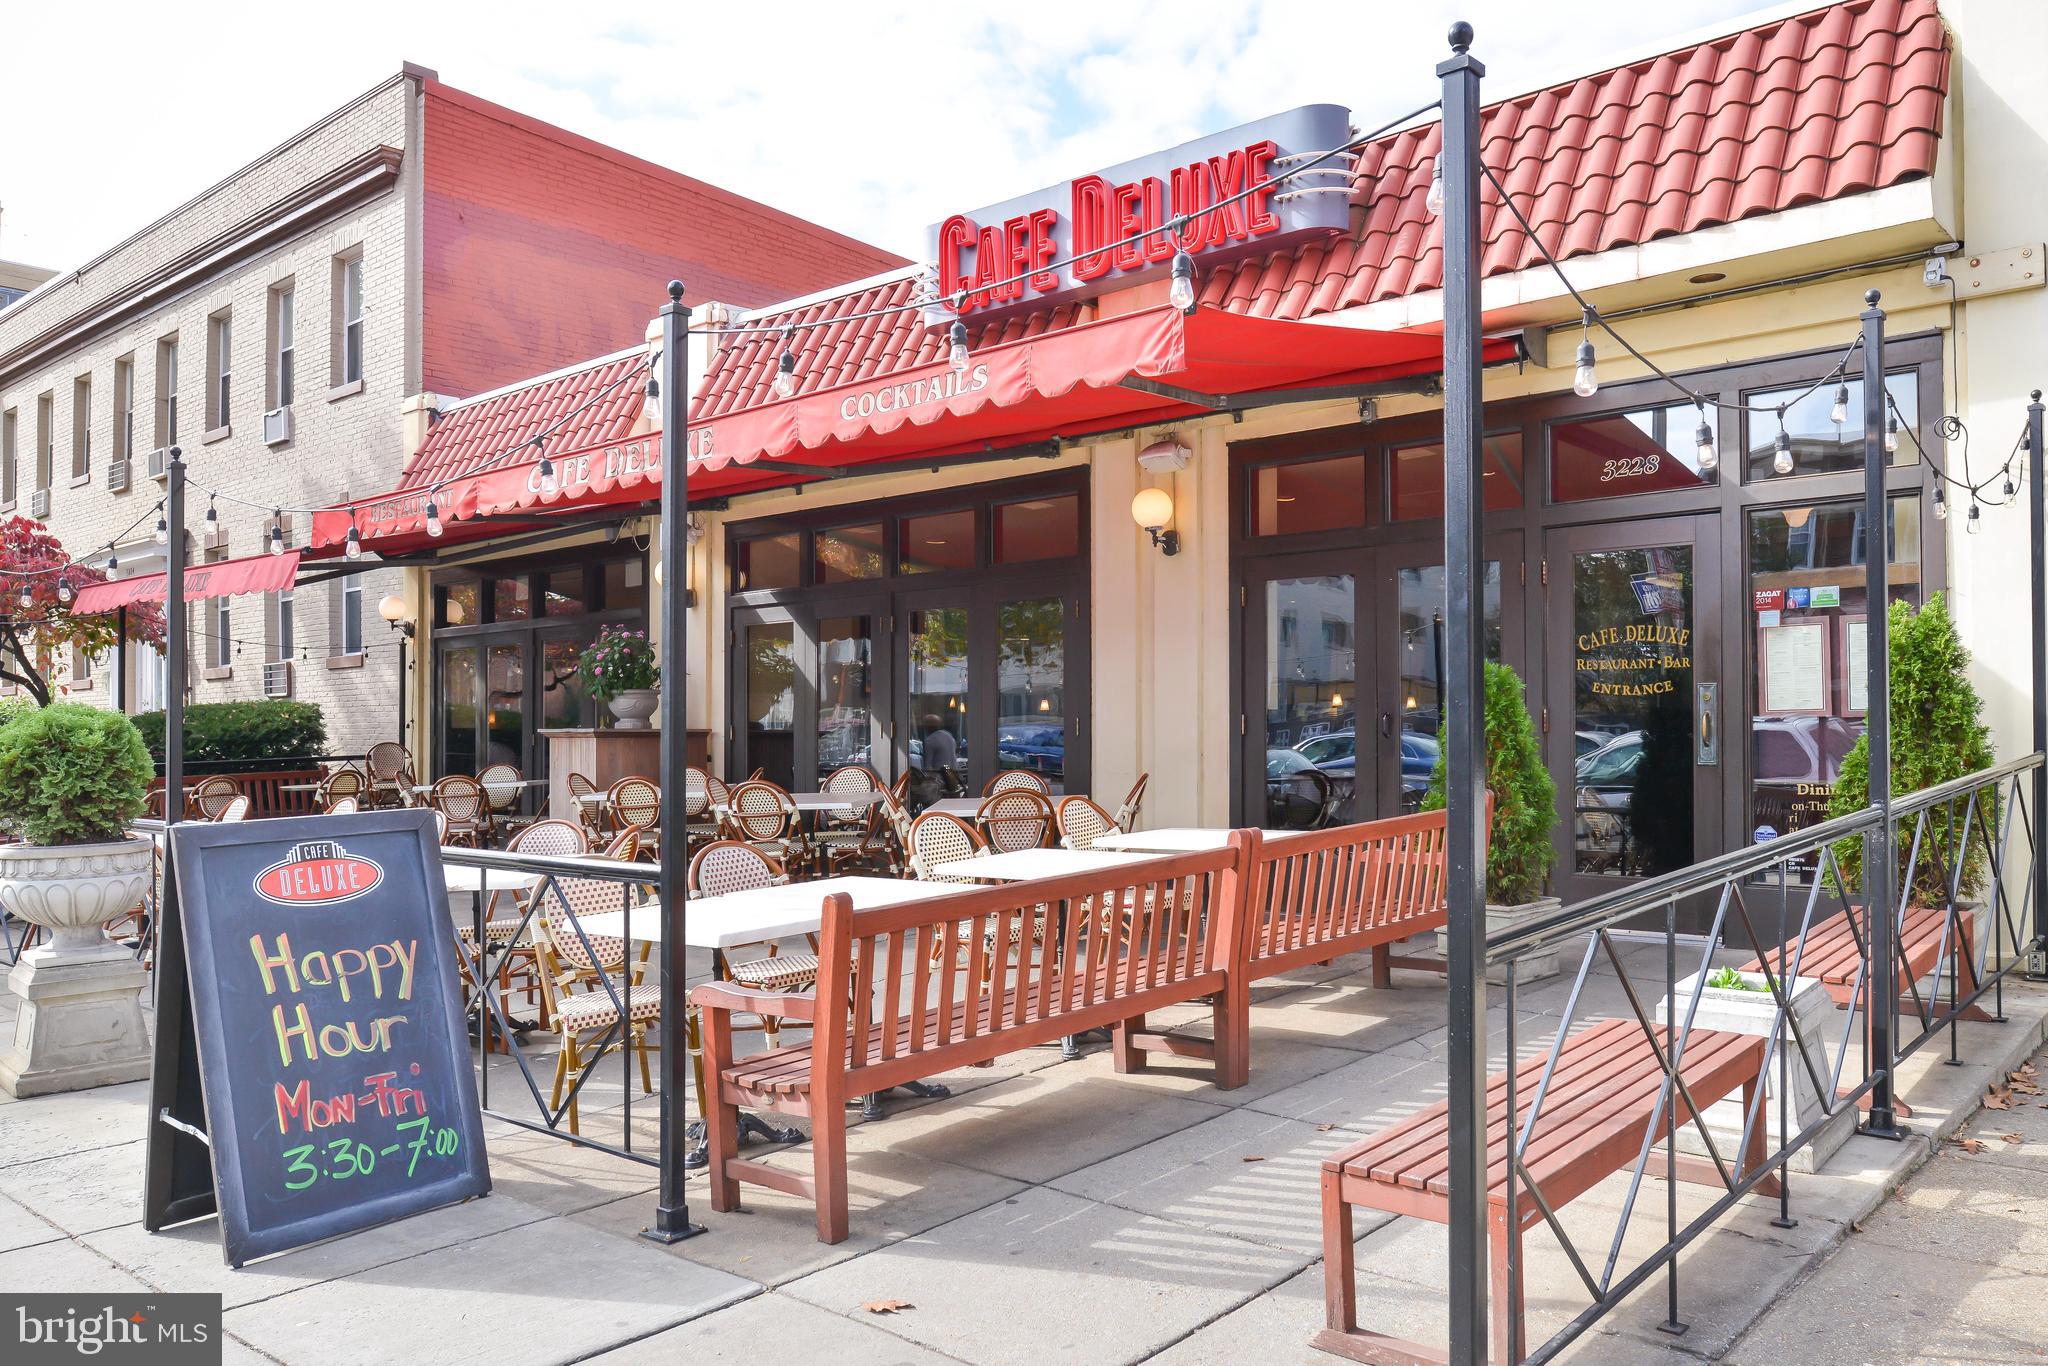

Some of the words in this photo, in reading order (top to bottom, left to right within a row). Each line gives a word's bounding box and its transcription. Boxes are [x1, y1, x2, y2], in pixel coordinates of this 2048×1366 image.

[939, 208, 1059, 314] CAFE
[1071, 140, 1280, 283] DELUXE
[840, 363, 989, 421] COCKTAILS
[1600, 454, 1660, 482] 3228
[1755, 590, 1781, 598] ZAGAT
[1755, 597, 1772, 605] 2014
[1578, 627, 1619, 651] CAFE
[1626, 624, 1690, 647] DELUXE
[1577, 658, 1656, 671] RESTAURANT
[1664, 656, 1690, 669] BAR
[1592, 681, 1674, 696] ENTRANCE
[303, 844, 329, 860] CAFE
[280, 863, 361, 897] DELUXE
[249, 932, 417, 1003] Happy
[272, 1002, 409, 1067] Hour
